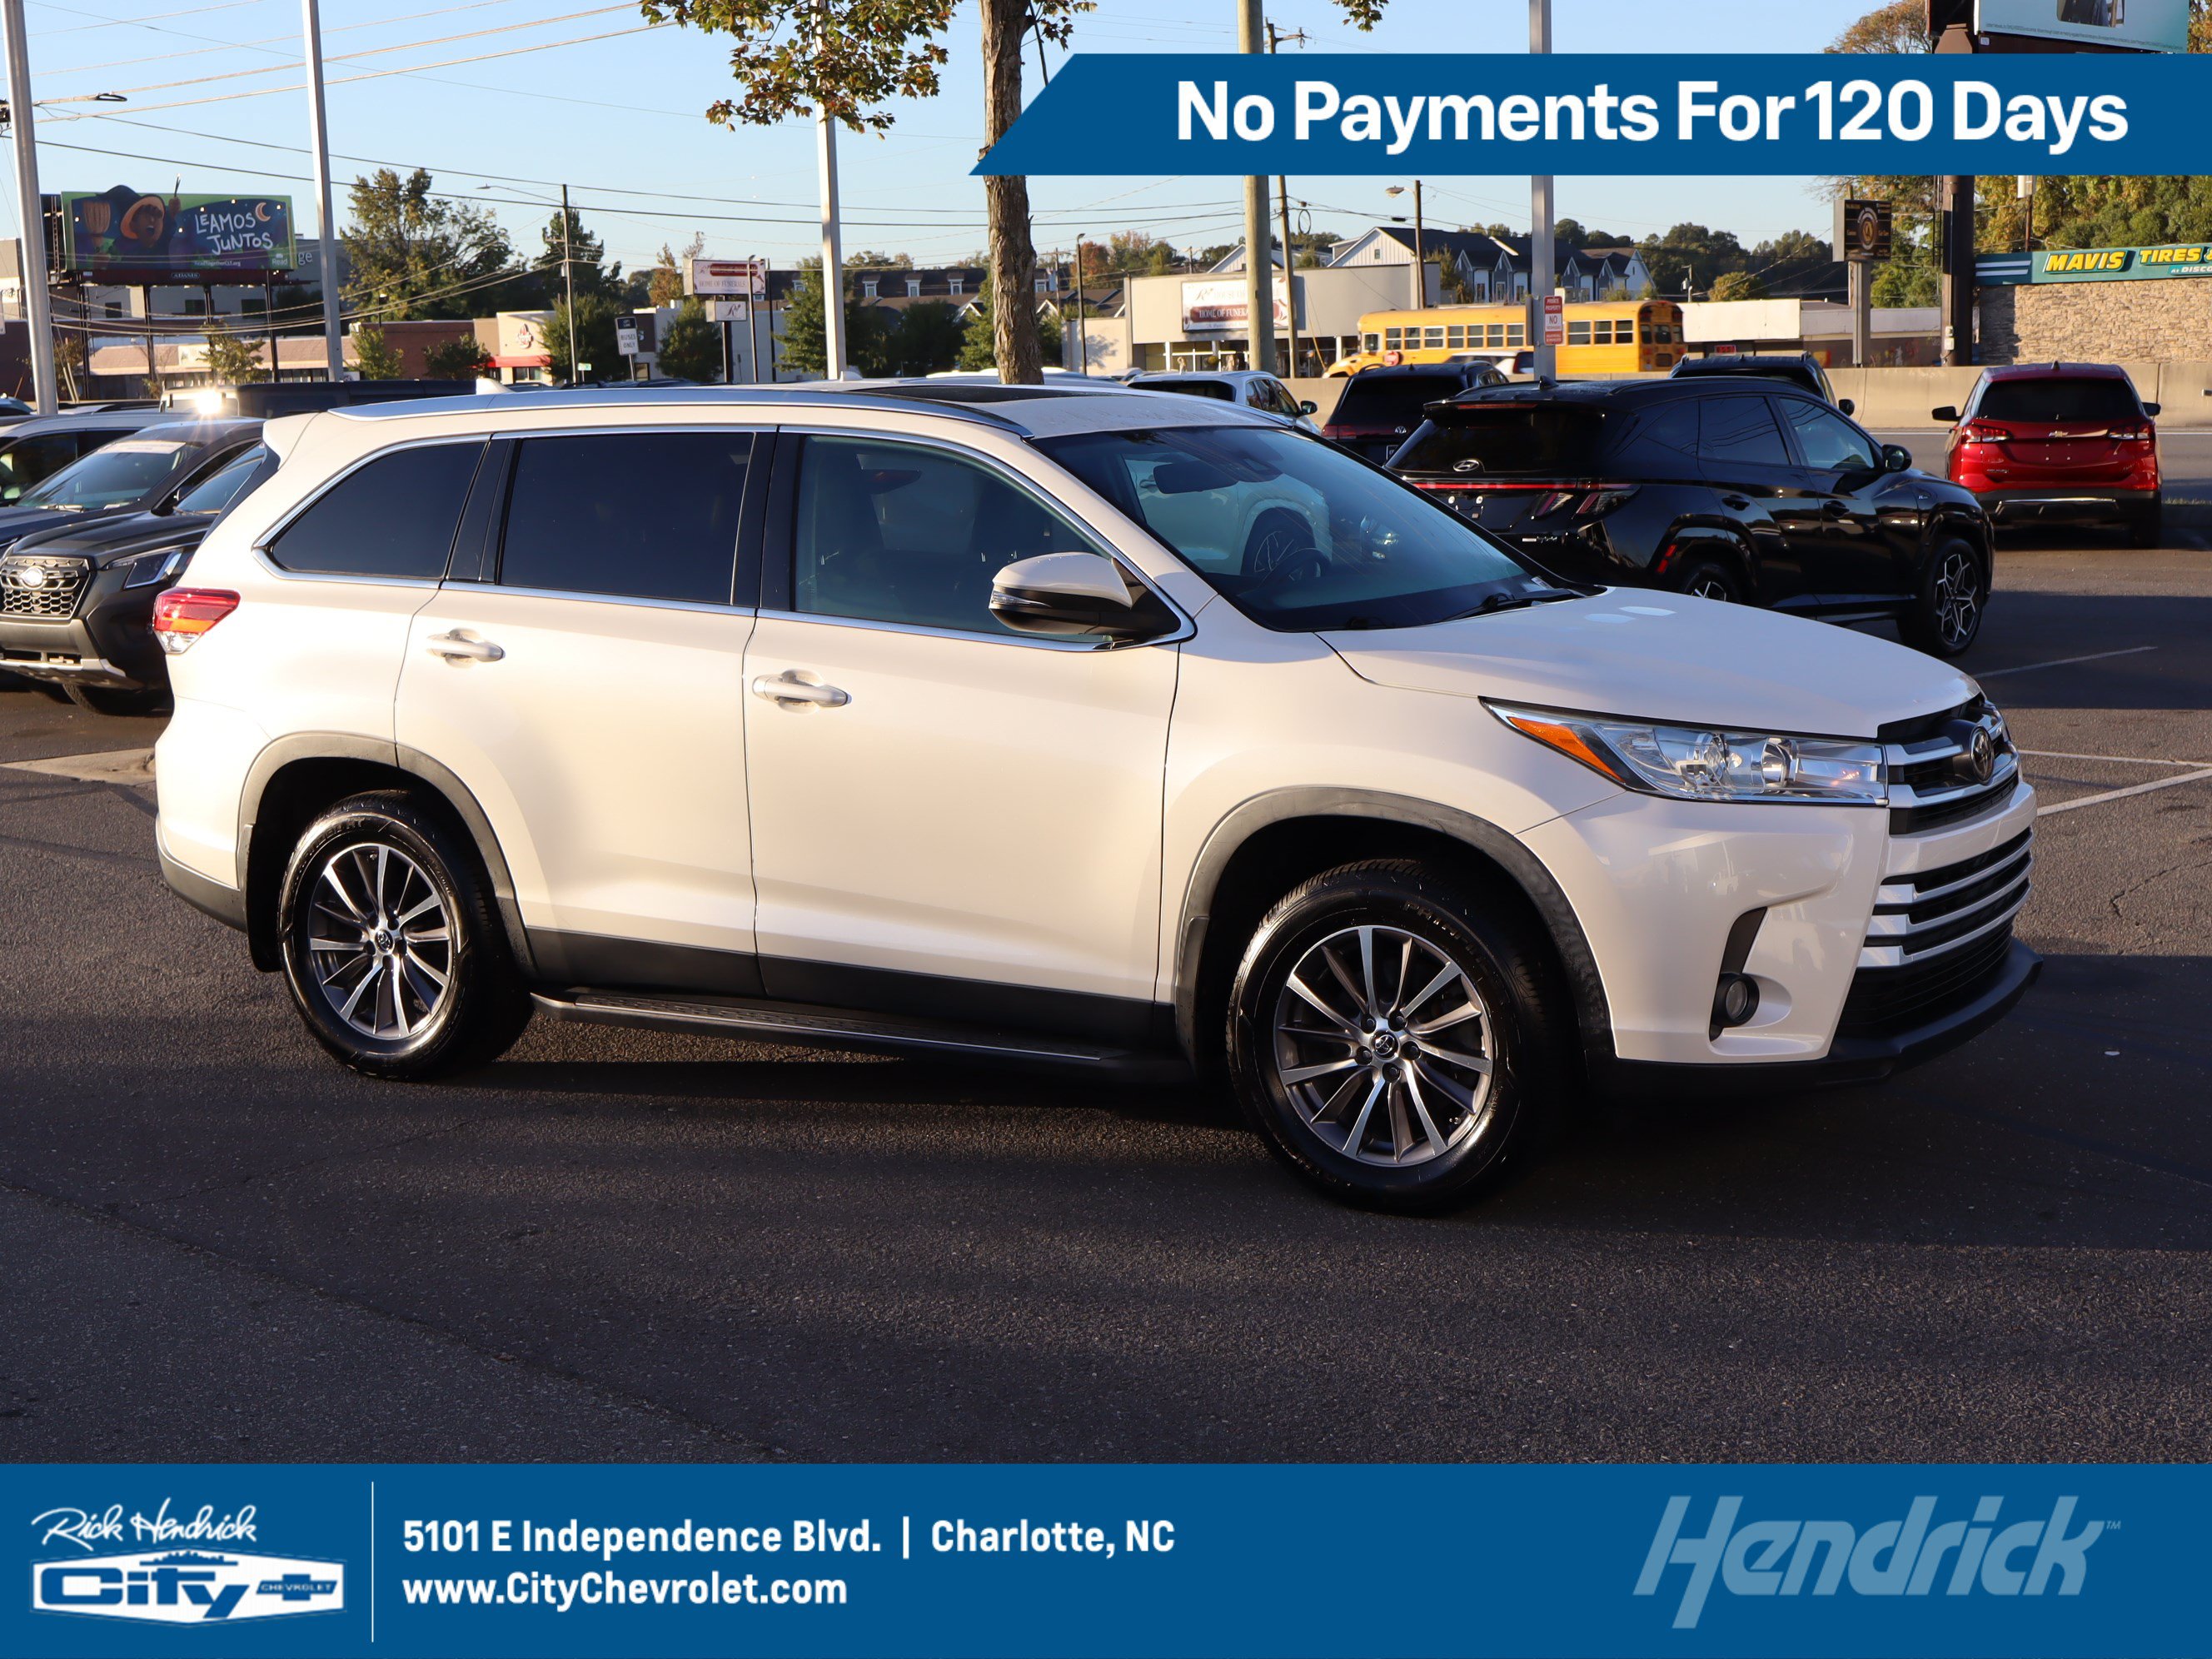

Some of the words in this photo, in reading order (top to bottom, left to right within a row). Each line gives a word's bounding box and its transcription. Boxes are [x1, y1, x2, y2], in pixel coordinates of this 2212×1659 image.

[2045, 251, 2126, 272] MAVIS
[2140, 247, 2202, 263] TIRES
[1549, 315, 1558, 325] NO
